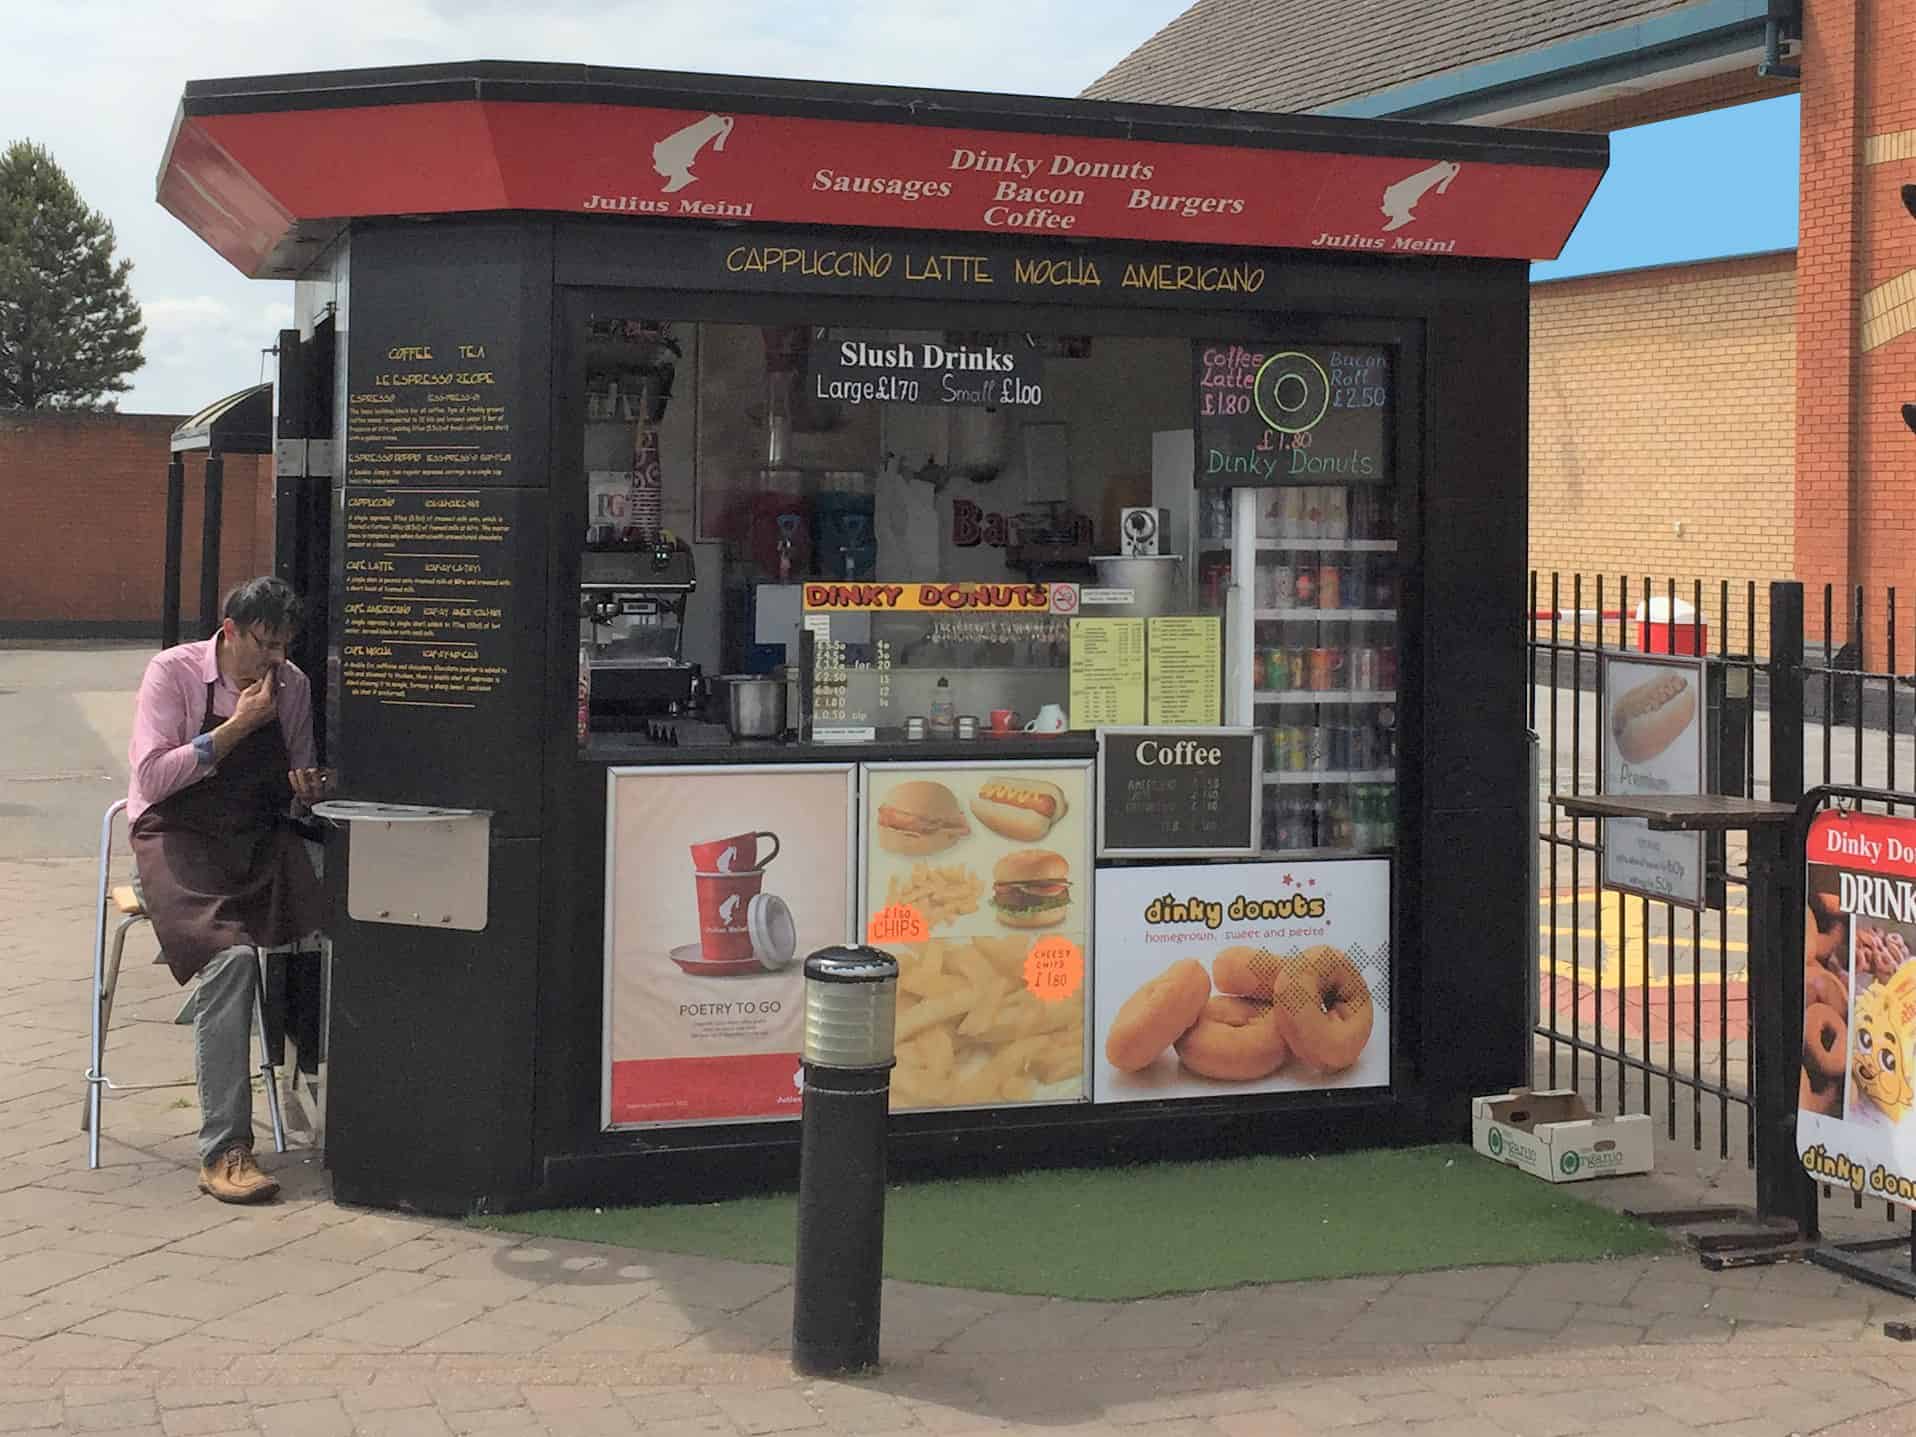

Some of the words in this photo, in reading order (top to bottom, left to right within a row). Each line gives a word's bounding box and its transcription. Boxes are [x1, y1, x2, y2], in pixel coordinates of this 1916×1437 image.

[950, 149, 1042, 177] Dinky
[1049, 154, 1155, 181] Donuts
[583, 194, 669, 215] Julius
[680, 199, 753, 218] Meinl
[812, 169, 952, 200] Sausages
[993, 180, 1085, 206] Bacon
[1128, 188, 1246, 218] Burgers
[983, 205, 1076, 231] Coffee
[1311, 232, 1386, 251] Julius
[1391, 236, 1457, 254] Meinl
[726, 245, 893, 279] CAPPUCCINO
[905, 255, 994, 284] LATTE
[1121, 261, 1265, 294] AMERICANO
[840, 341, 914, 369] Slush
[923, 344, 1015, 372] Drinks
[1203, 346, 1265, 369] Coffee
[941, 373, 995, 402] Small
[1200, 367, 1255, 389] Latte
[1288, 448, 1374, 476] Donuts
[806, 584, 904, 609] DINKY
[919, 584, 1049, 609] DONUTS
[1135, 740, 1222, 766] Coffee
[1826, 828, 1883, 865] Dinky
[1887, 837, 1916, 865] Do
[1145, 892, 1224, 930] dinky
[1228, 892, 1326, 921] donuts
[873, 919, 921, 939] CHIPS
[1264, 928, 1286, 938] and
[679, 1003, 731, 1017] POETRY
[735, 1002, 756, 1014] TO
[758, 1001, 782, 1013] GO
[1801, 1143, 1866, 1193] dinky
[1870, 1164, 1916, 1200] don
